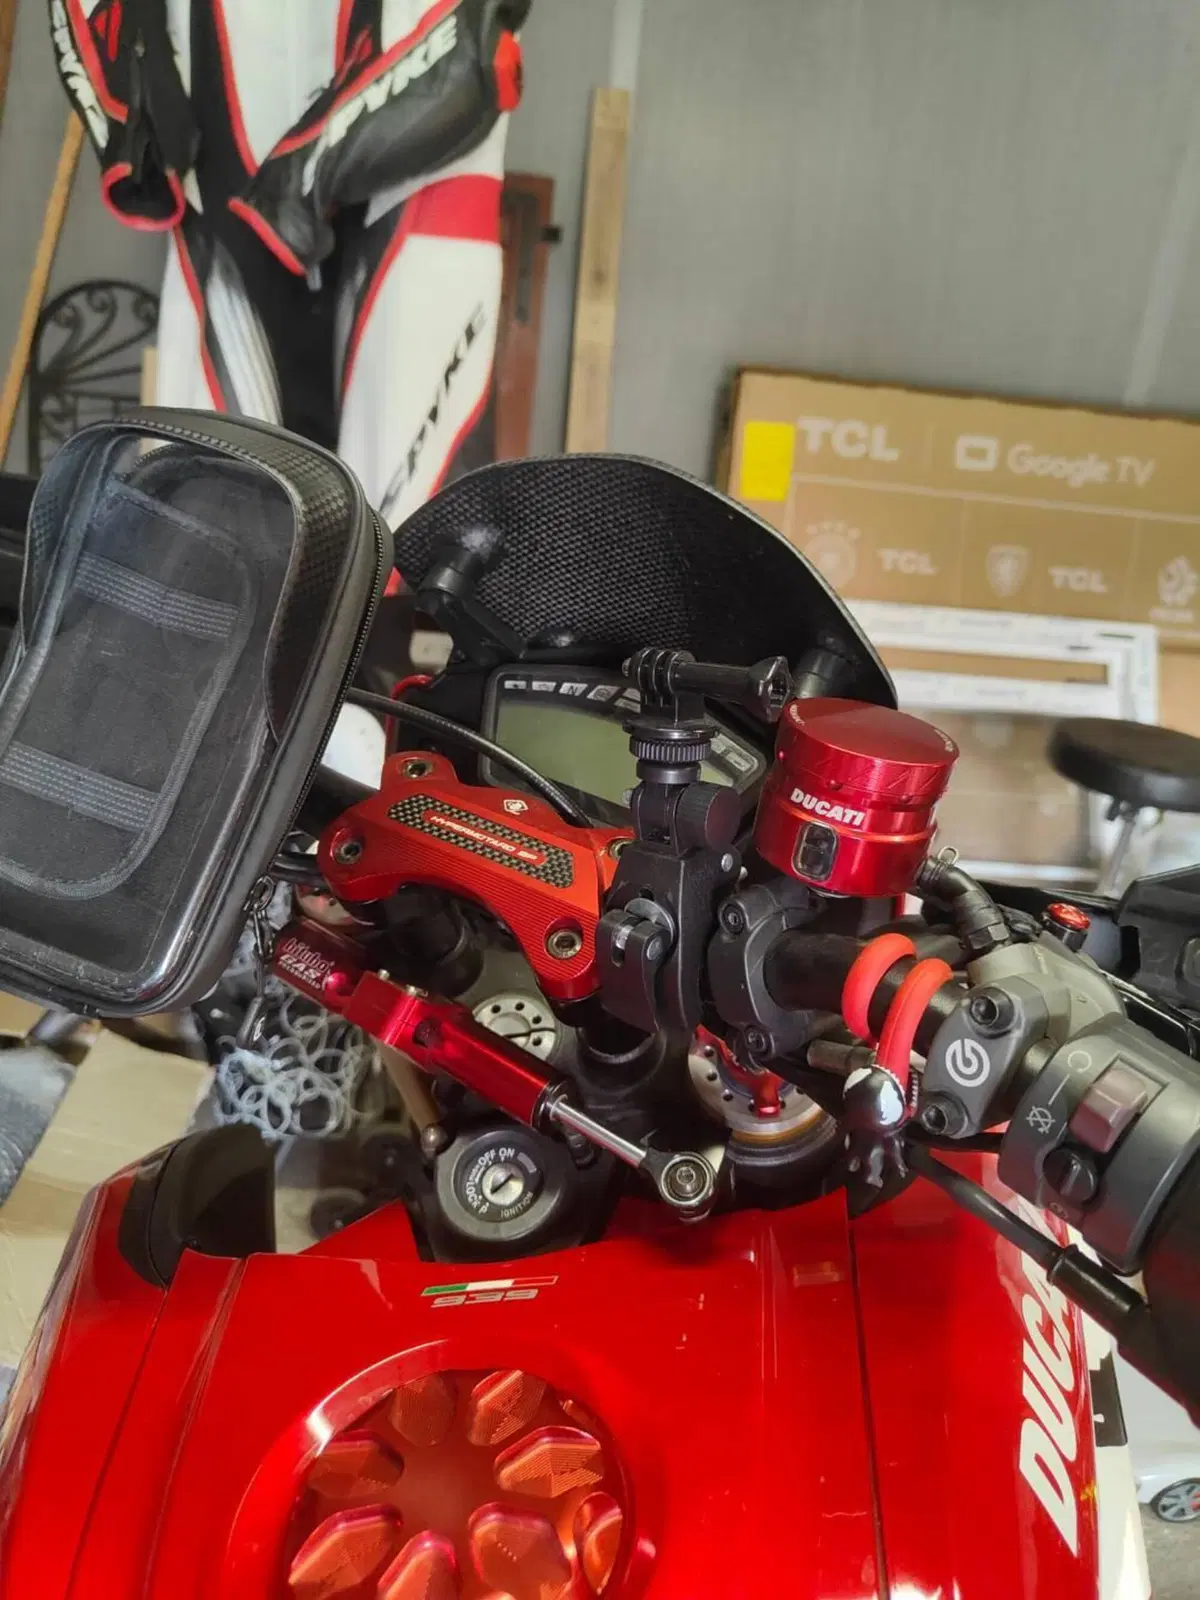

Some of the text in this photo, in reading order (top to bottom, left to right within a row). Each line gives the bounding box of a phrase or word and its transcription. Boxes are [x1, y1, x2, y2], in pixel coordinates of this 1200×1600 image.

[797, 416, 899, 462] TCL
[1006, 443, 1157, 487] Google TV
[877, 547, 939, 576] TCL
[1048, 565, 1108, 594] TCL
[790, 787, 867, 827] DUCATI
[430, 816, 516, 852] HYPERMOTARD
[279, 954, 322, 979] GAS
[478, 1148, 496, 1166] OFF
[499, 1147, 516, 1159] ON
[466, 1182, 481, 1209] LOCK
[500, 1191, 534, 1218] IGNITION
[430, 1288, 539, 1308] 939
[1015, 1194, 1078, 1558] DUCA
